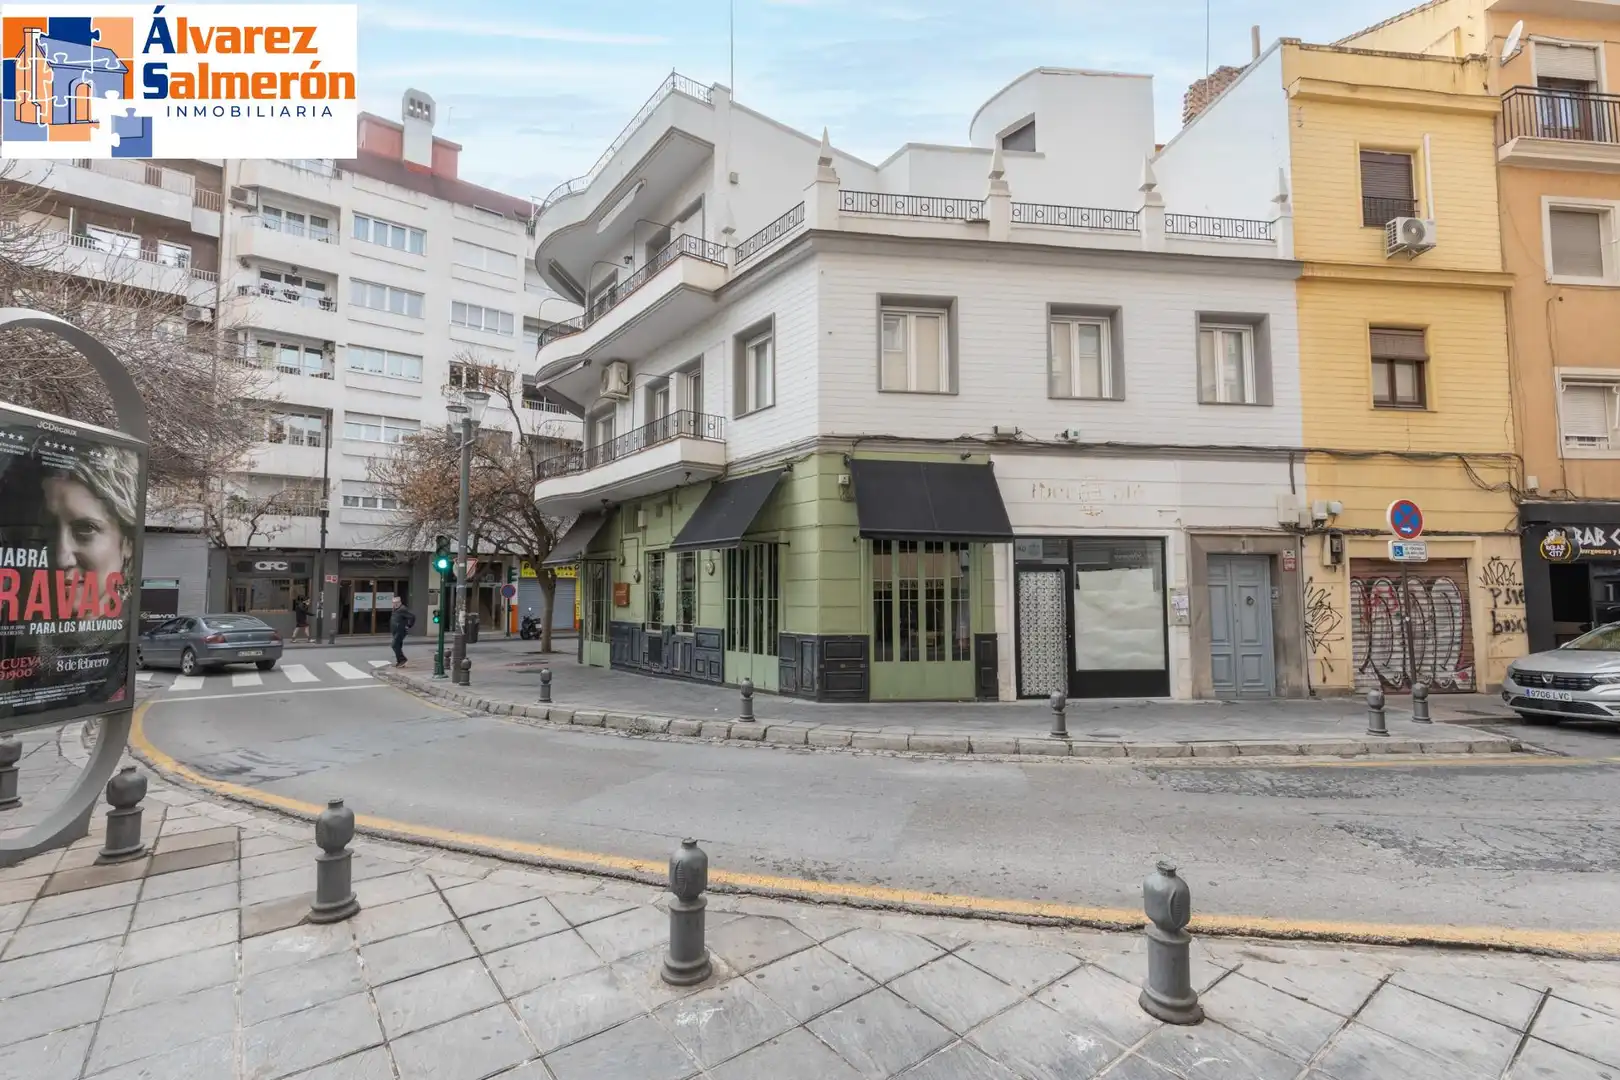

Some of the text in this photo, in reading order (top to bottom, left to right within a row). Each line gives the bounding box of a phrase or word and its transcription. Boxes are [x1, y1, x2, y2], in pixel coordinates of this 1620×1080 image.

[37, 421, 77, 436] JCDecaux
[29, 621, 56, 635] PARA
[58, 621, 76, 633] LOS
[78, 619, 123, 633] MALVADOS
[1, 655, 42, 670] CUEVA
[56, 657, 109, 672] 8 de febrero
[1531, 690, 1570, 700] 9706 LVC
